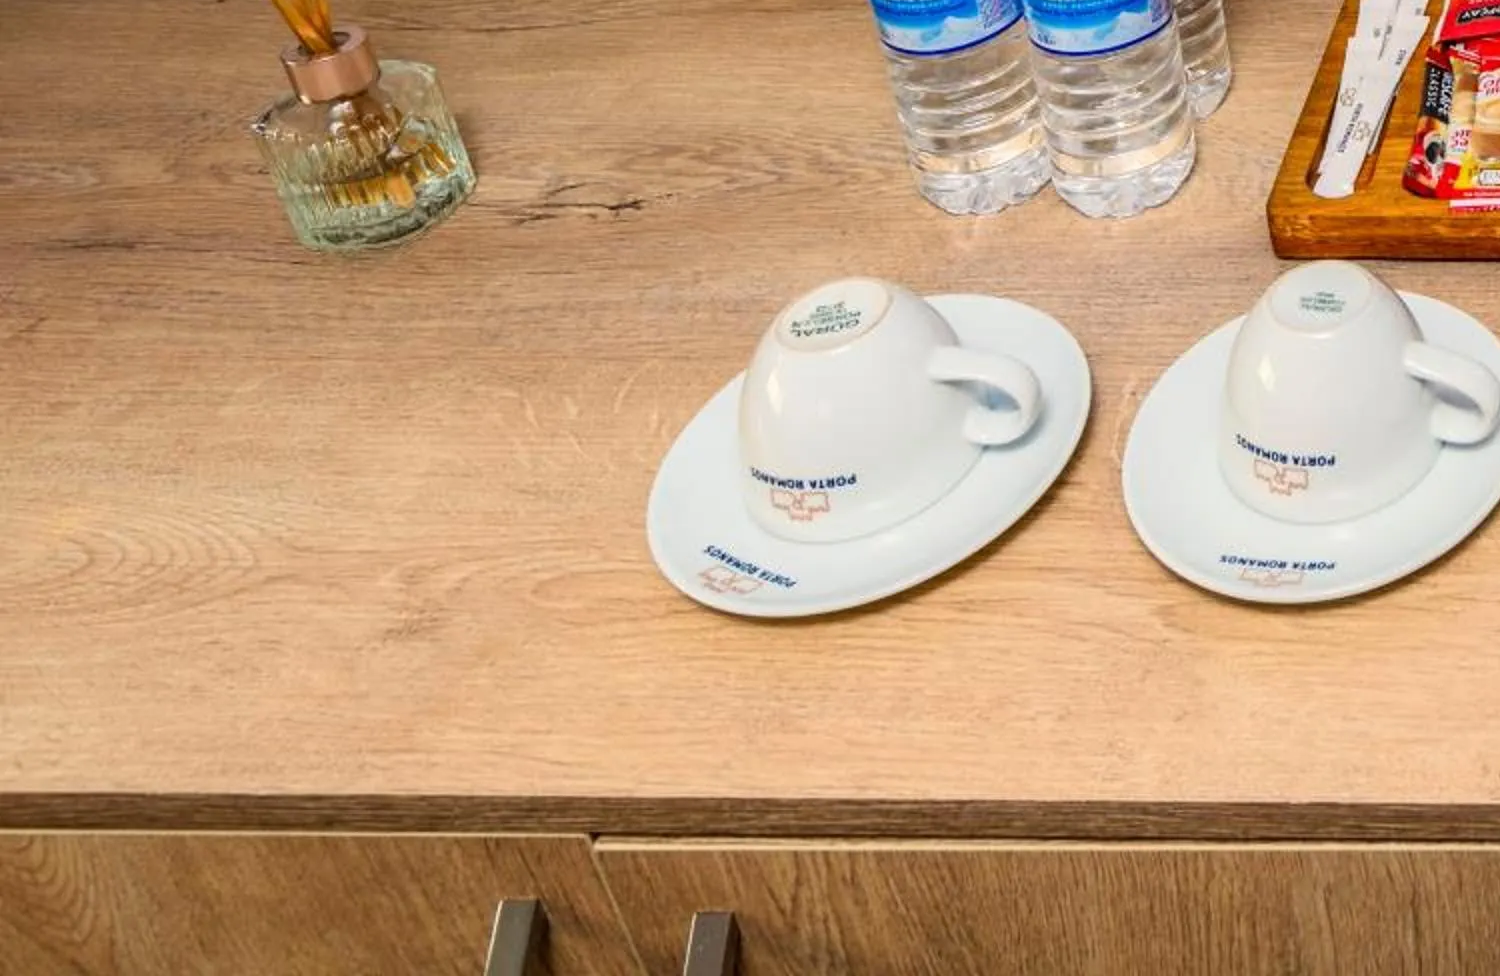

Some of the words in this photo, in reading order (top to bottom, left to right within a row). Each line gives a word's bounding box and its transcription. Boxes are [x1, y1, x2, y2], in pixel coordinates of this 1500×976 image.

[1291, 455, 1337, 467] PORTA
[809, 473, 858, 490] PORTA
[1219, 554, 1288, 570] ROMANOS
[1291, 561, 1338, 571] PORTA
